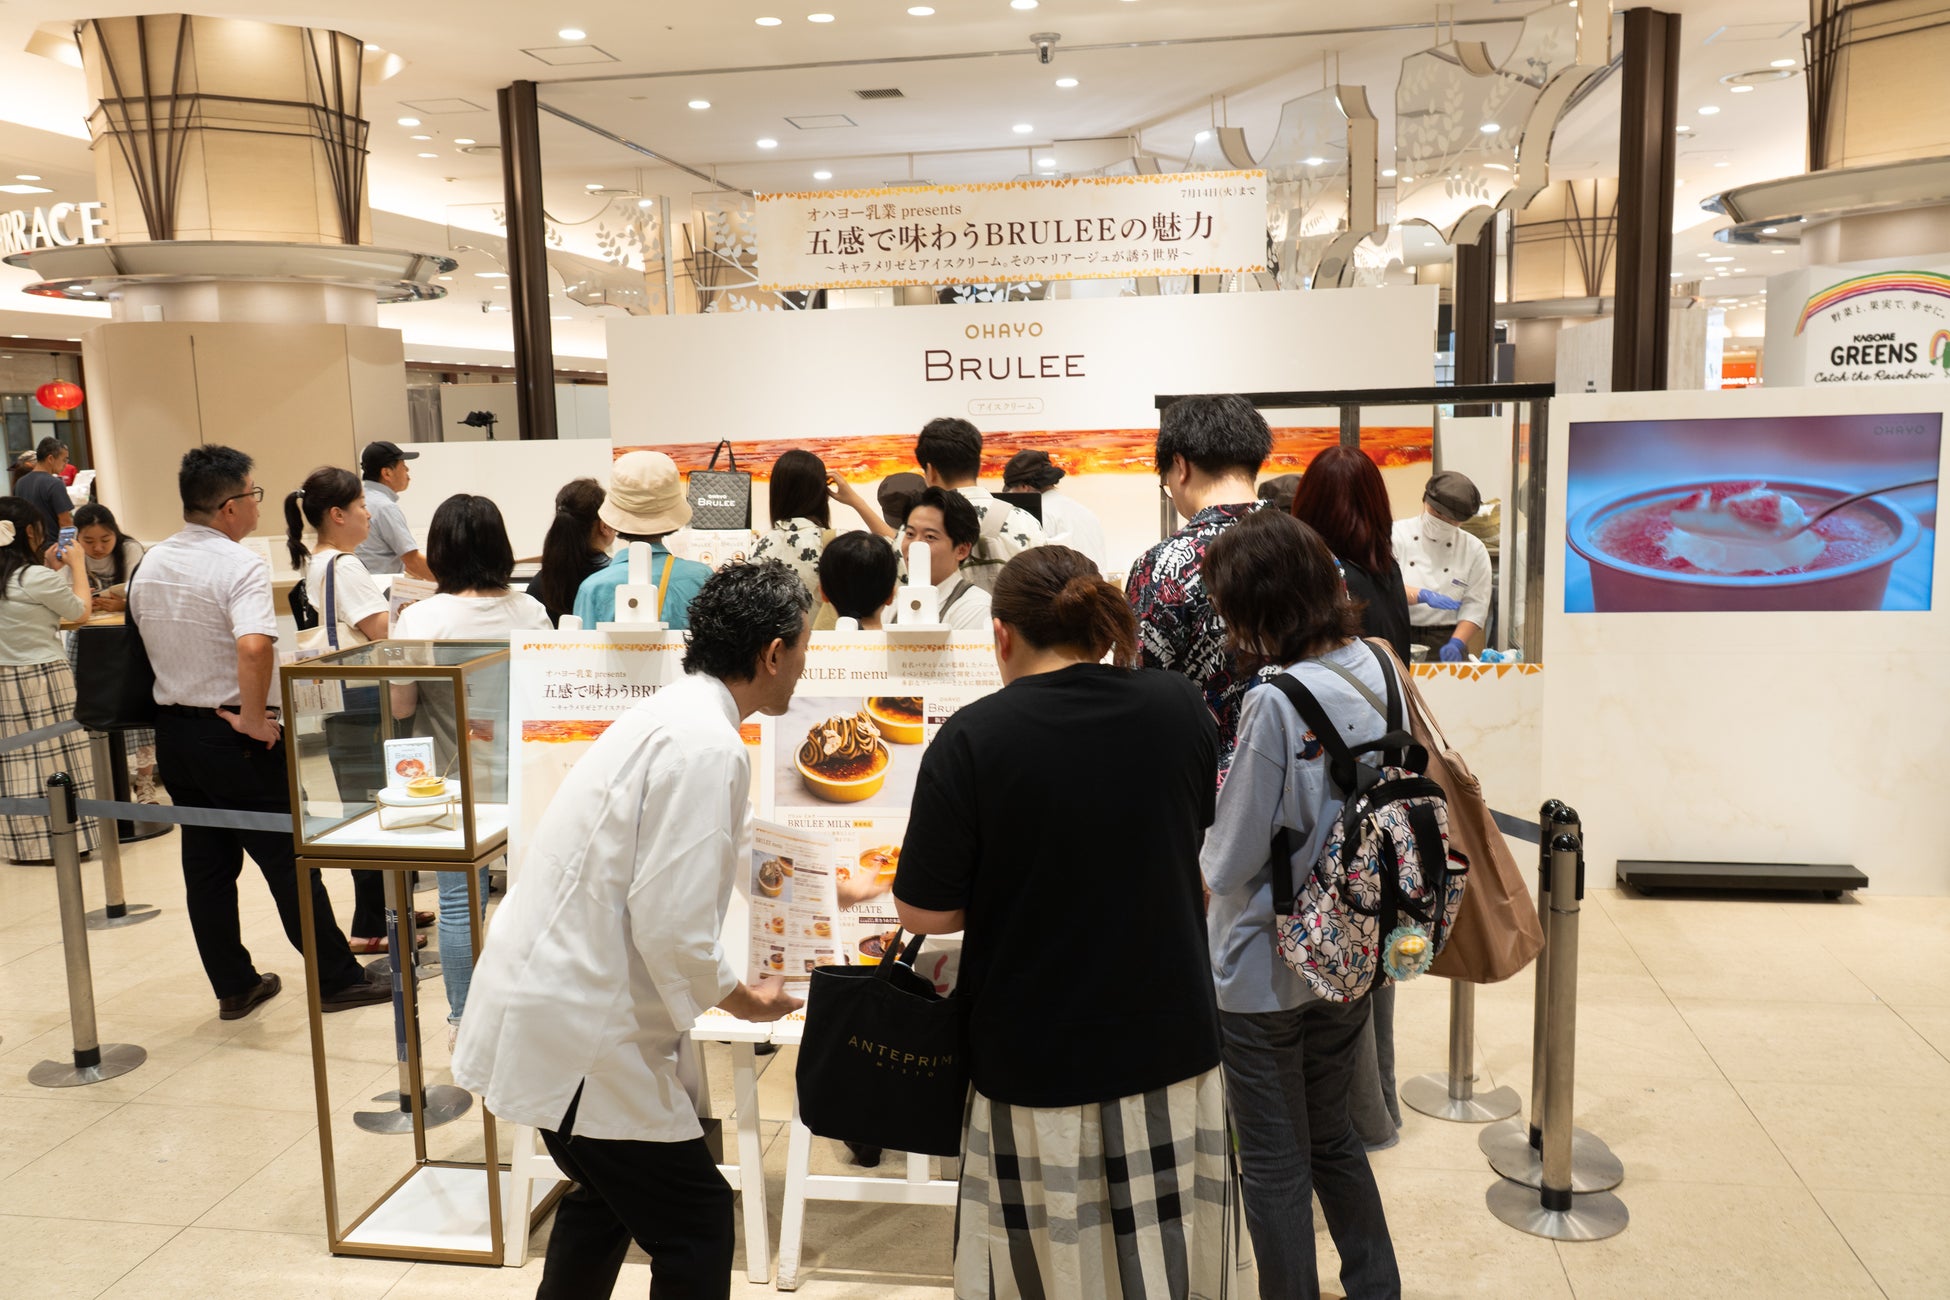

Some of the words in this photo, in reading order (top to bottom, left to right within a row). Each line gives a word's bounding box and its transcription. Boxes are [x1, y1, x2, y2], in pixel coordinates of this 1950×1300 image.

[807, 203, 897, 222] オハヨー乳業
[901, 203, 962, 220] presents
[0, 202, 106, 254] RRACE
[805, 211, 1213, 256] 五感で味わうBRULEEの魅力
[965, 321, 1044, 340] OHAYO
[1853, 332, 1896, 343] KAGOME
[1830, 342, 1918, 367] GREENS
[925, 349, 1086, 382] BRULEE
[1814, 370, 1848, 383] Catch
[1851, 370, 1872, 382] the
[1874, 368, 1934, 381] Rainbow
[976, 401, 1036, 412] アイスクリーム
[1873, 424, 1926, 436] OHAYO
[595, 670, 626, 678] presents
[799, 668, 847, 680] RULEE
[851, 670, 888, 680] menu
[928, 703, 963, 713] BRUL
[788, 819, 824, 828] BRULEE
[827, 820, 851, 828] MILK
[848, 1034, 953, 1068] ANTEPRIM
